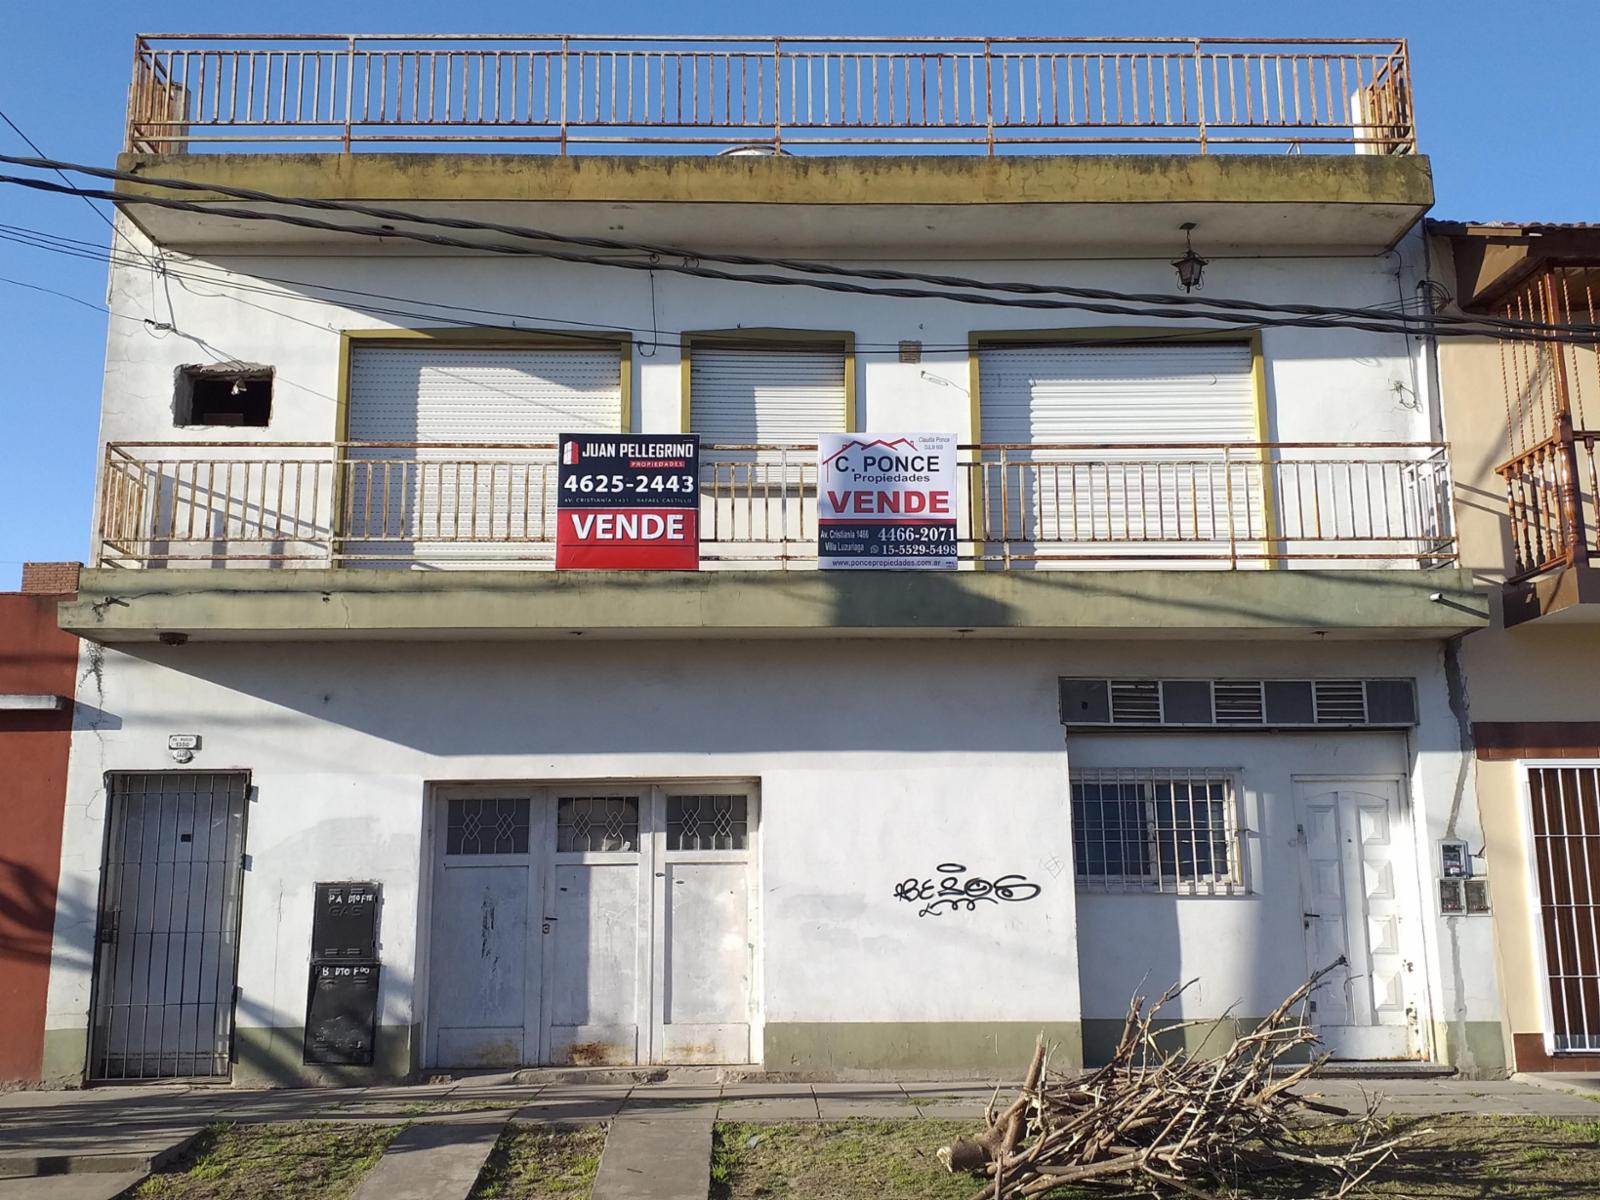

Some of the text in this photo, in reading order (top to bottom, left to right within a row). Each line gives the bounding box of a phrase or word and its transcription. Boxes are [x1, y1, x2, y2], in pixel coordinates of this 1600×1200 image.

[582, 443, 694, 458] JUAN PELLEGRINO
[835, 455, 940, 473] C. PONCE
[564, 474, 694, 493] 4625-2443
[853, 473, 931, 484] Propiedades
[827, 490, 950, 513] VENDE
[571, 514, 684, 540] VENDE
[878, 527, 956, 541] 4466-2071
[883, 545, 957, 555] 15-5529-5498
[832, 559, 941, 567] www.poncepropiedades.com.ar
[328, 905, 363, 916] GAS
